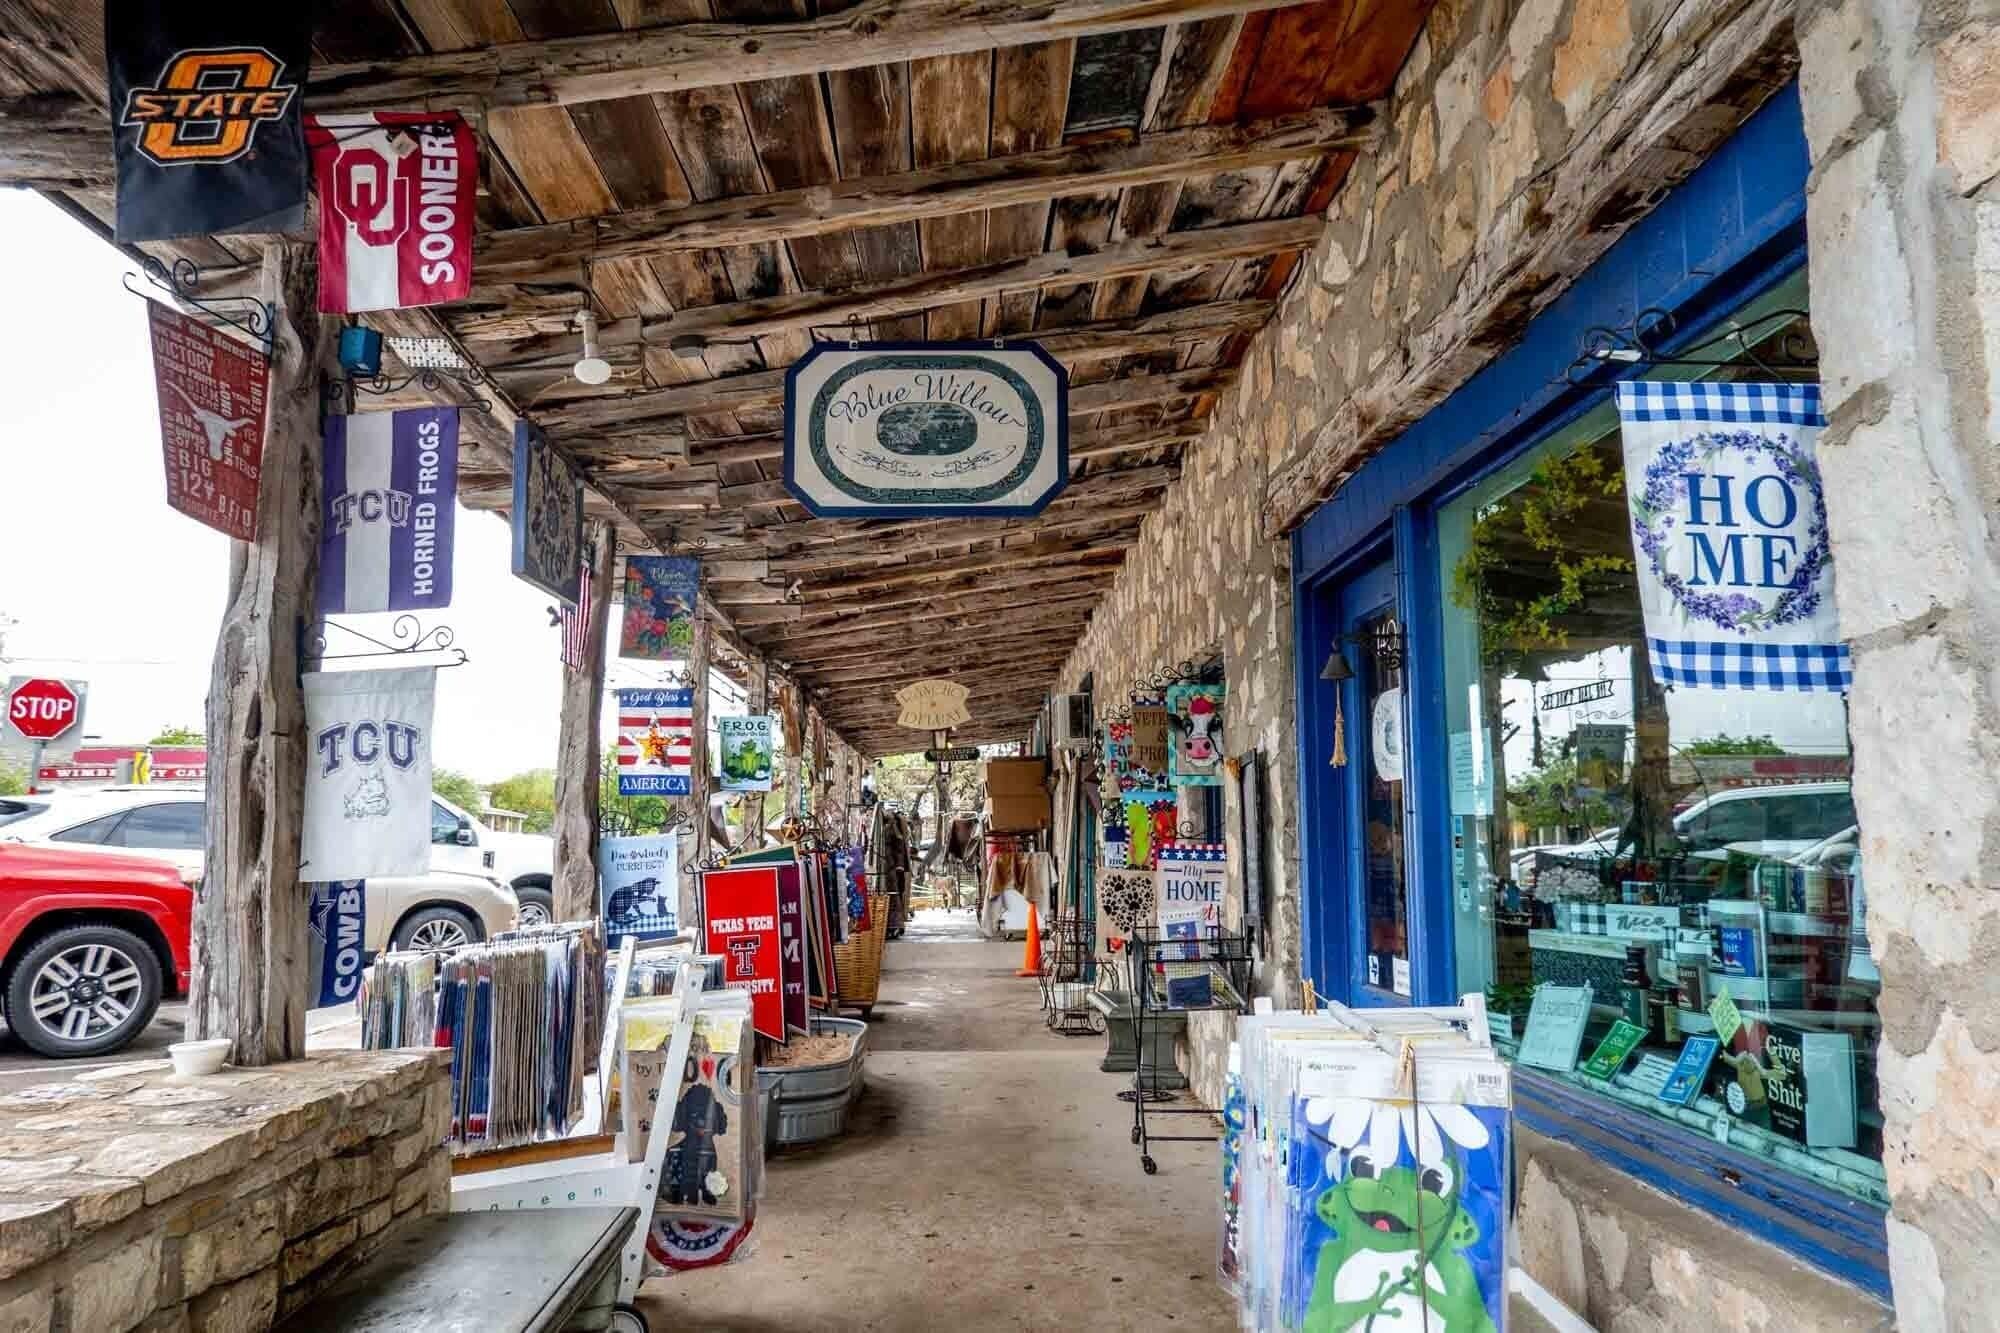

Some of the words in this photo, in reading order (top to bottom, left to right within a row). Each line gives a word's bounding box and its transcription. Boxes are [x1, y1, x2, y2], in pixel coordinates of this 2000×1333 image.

[131, 92, 288, 118] STATE
[418, 121, 459, 286] SOONER
[154, 332, 213, 377] VICTORY
[829, 383, 911, 425] Blue
[914, 374, 1026, 428] Willow
[332, 489, 412, 534] TCU
[1678, 473, 1798, 530] HO
[413, 502, 437, 596] HORNED
[1684, 531, 1801, 590] ME
[13, 696, 73, 720] STOP
[628, 690, 652, 706] God
[654, 691, 680, 707] Bless
[723, 721, 769, 731] F.R.O.G.
[317, 718, 420, 778] TCU
[620, 777, 687, 791] AMERICA
[1184, 864, 1202, 880] My
[1167, 880, 1221, 901] HOME
[711, 918, 744, 934] TEXAS
[746, 915, 774, 932] TECH
[1766, 1034, 1801, 1063] Give
[1768, 1078, 1803, 1111] Shit
